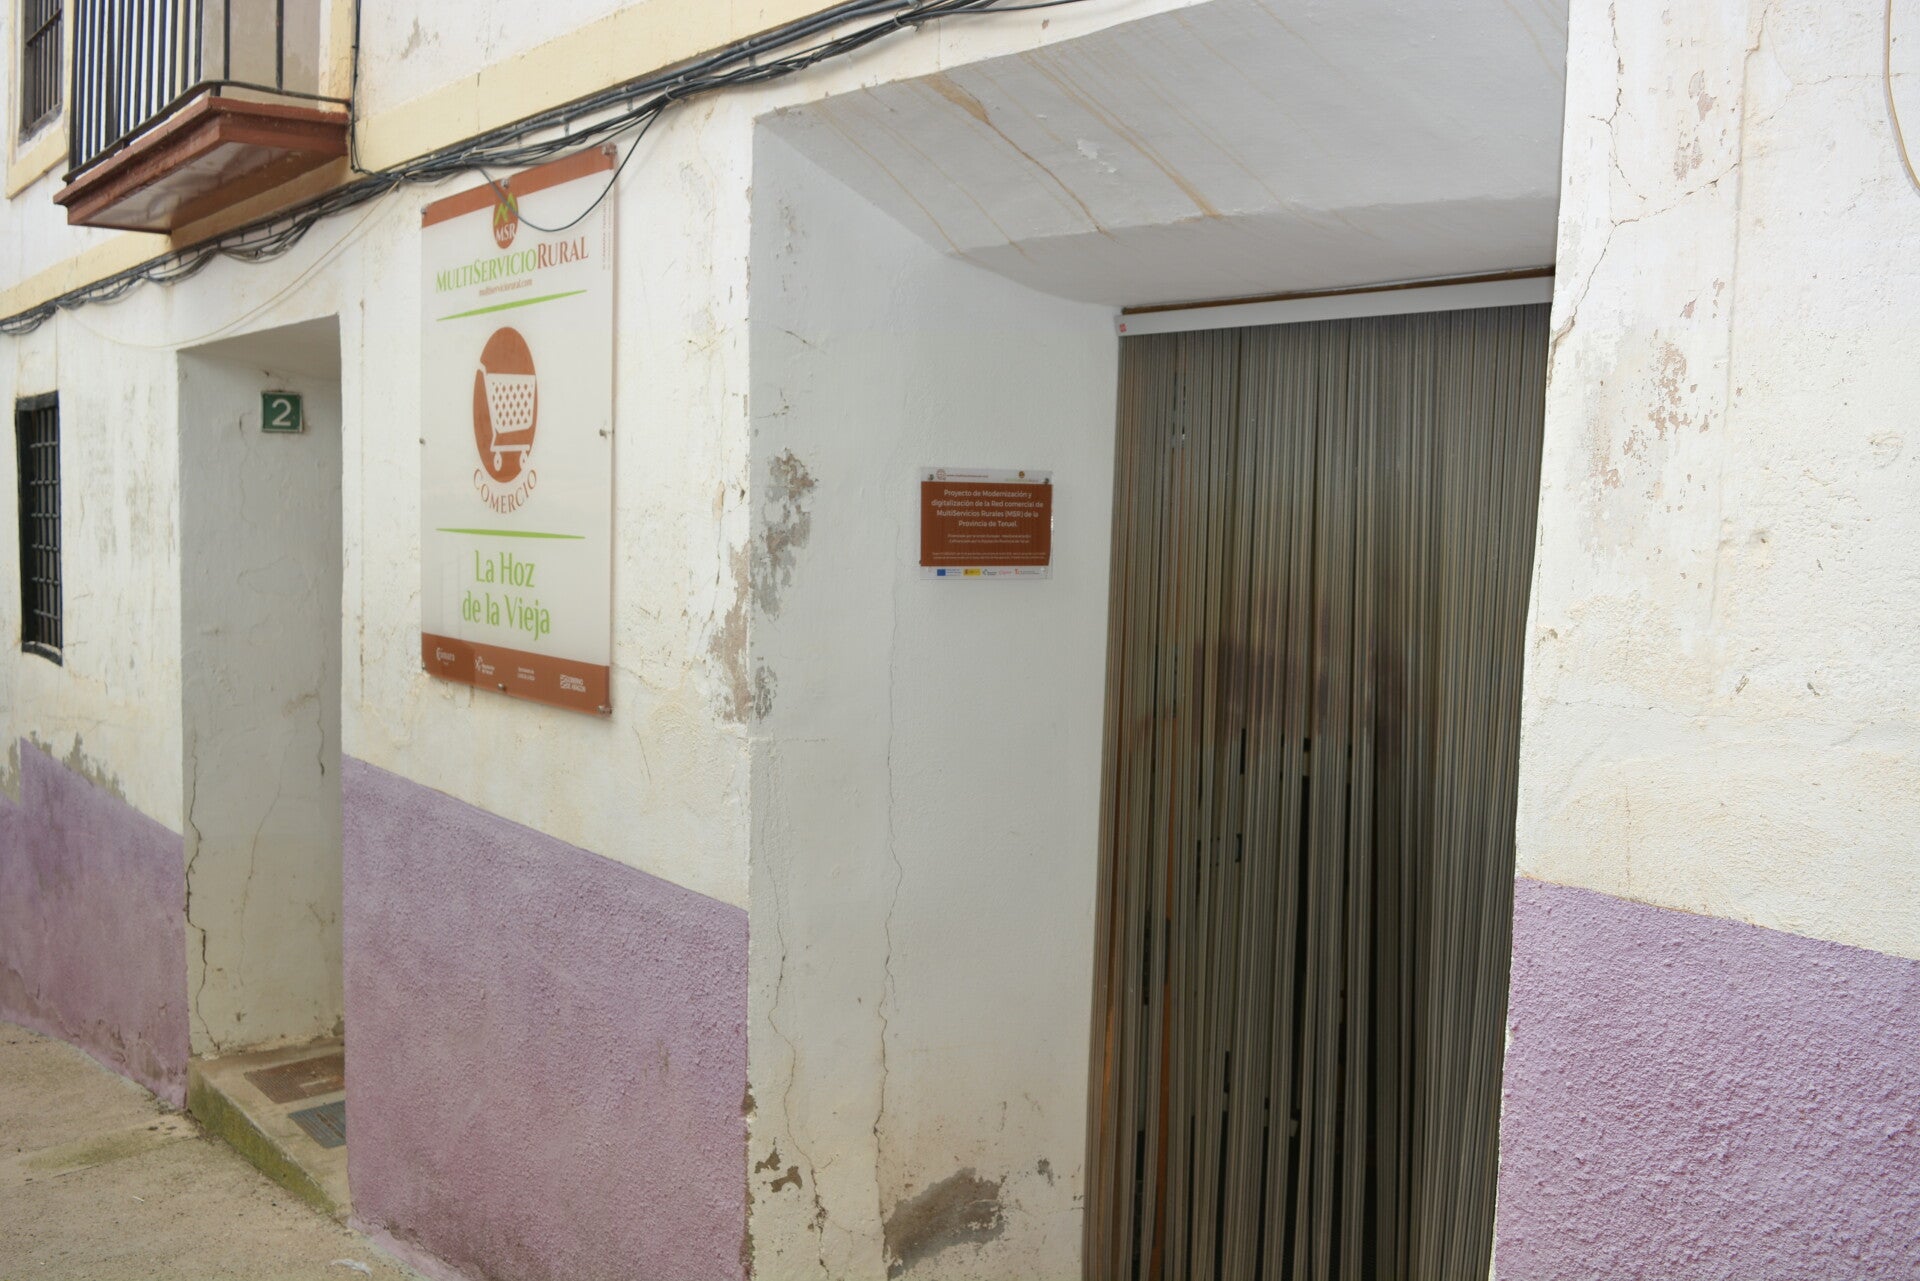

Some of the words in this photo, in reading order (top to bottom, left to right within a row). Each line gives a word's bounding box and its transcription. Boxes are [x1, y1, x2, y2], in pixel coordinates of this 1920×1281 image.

[495, 222, 516, 242] MSR
[272, 398, 291, 426] 2
[473, 467, 537, 514] COMERCIO
[944, 489, 972, 498] Proyecto
[931, 499, 974, 507] digitalización
[1024, 510, 1032, 518] de
[475, 550, 494, 583] La
[500, 551, 535, 588] Hoz
[462, 590, 481, 623] de
[485, 592, 500, 627] la
[504, 594, 551, 641] Vieja
